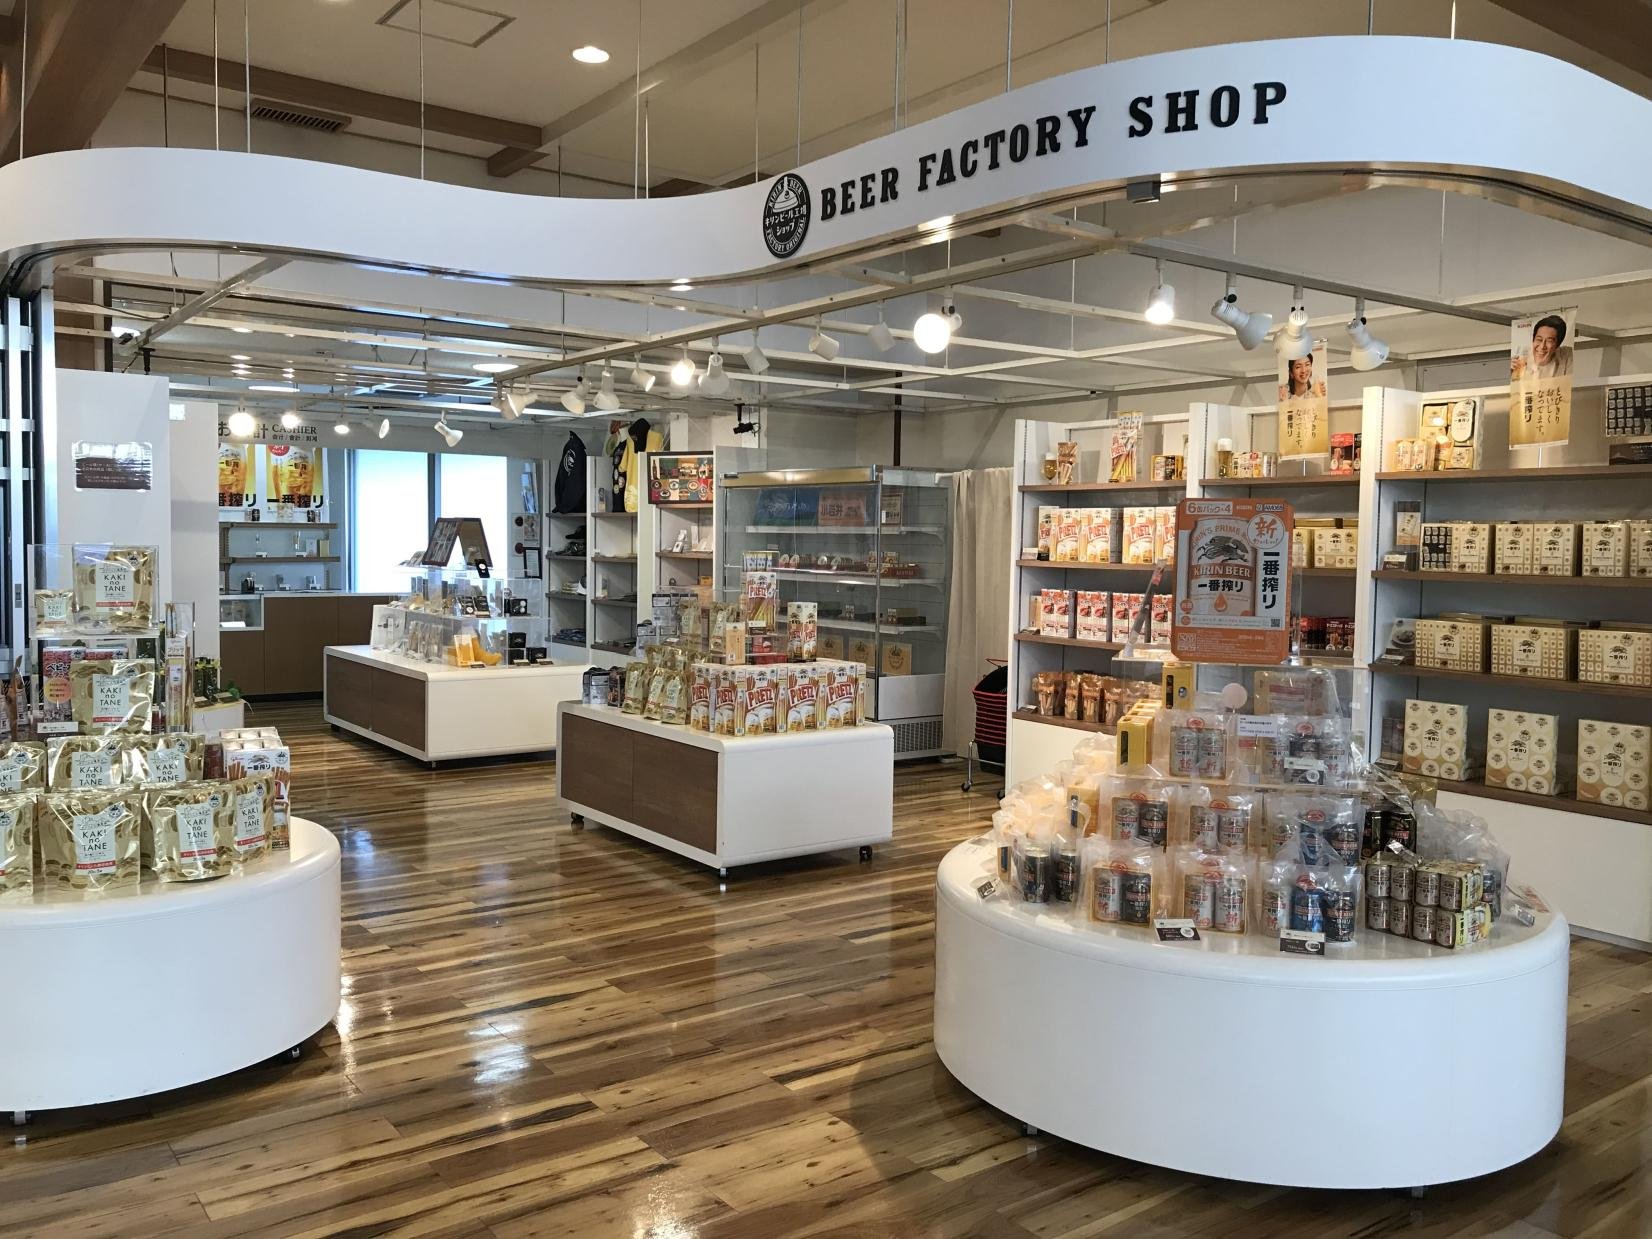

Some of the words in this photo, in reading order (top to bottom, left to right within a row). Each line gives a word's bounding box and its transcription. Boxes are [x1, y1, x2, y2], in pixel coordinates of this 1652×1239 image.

[821, 166, 899, 221] BEER
[918, 105, 1097, 191] FACTORY
[1128, 81, 1288, 138] SHOP
[272, 423, 317, 435] CASHIER
[1255, 516, 1277, 539] 新
[1194, 563, 1224, 577] KIRIN
[1225, 565, 1250, 578] BEER
[1197, 578, 1244, 593] 一番搾り
[1262, 551, 1280, 610] 一番搾り
[790, 685, 815, 705] PRETZ
[828, 682, 853, 702] PRETZ
[747, 688, 773, 708] PRETZ
[80, 766, 103, 774] KAKI
[156, 763, 178, 771] KAKI
[80, 778, 103, 787] TANE
[157, 774, 179, 783] TANE
[242, 807, 259, 817] KAKI
[186, 818, 207, 827] KAKI
[244, 818, 260, 828] TANE
[82, 829, 107, 839] KAKI
[186, 831, 208, 840] TANE
[82, 843, 108, 852] TANE
